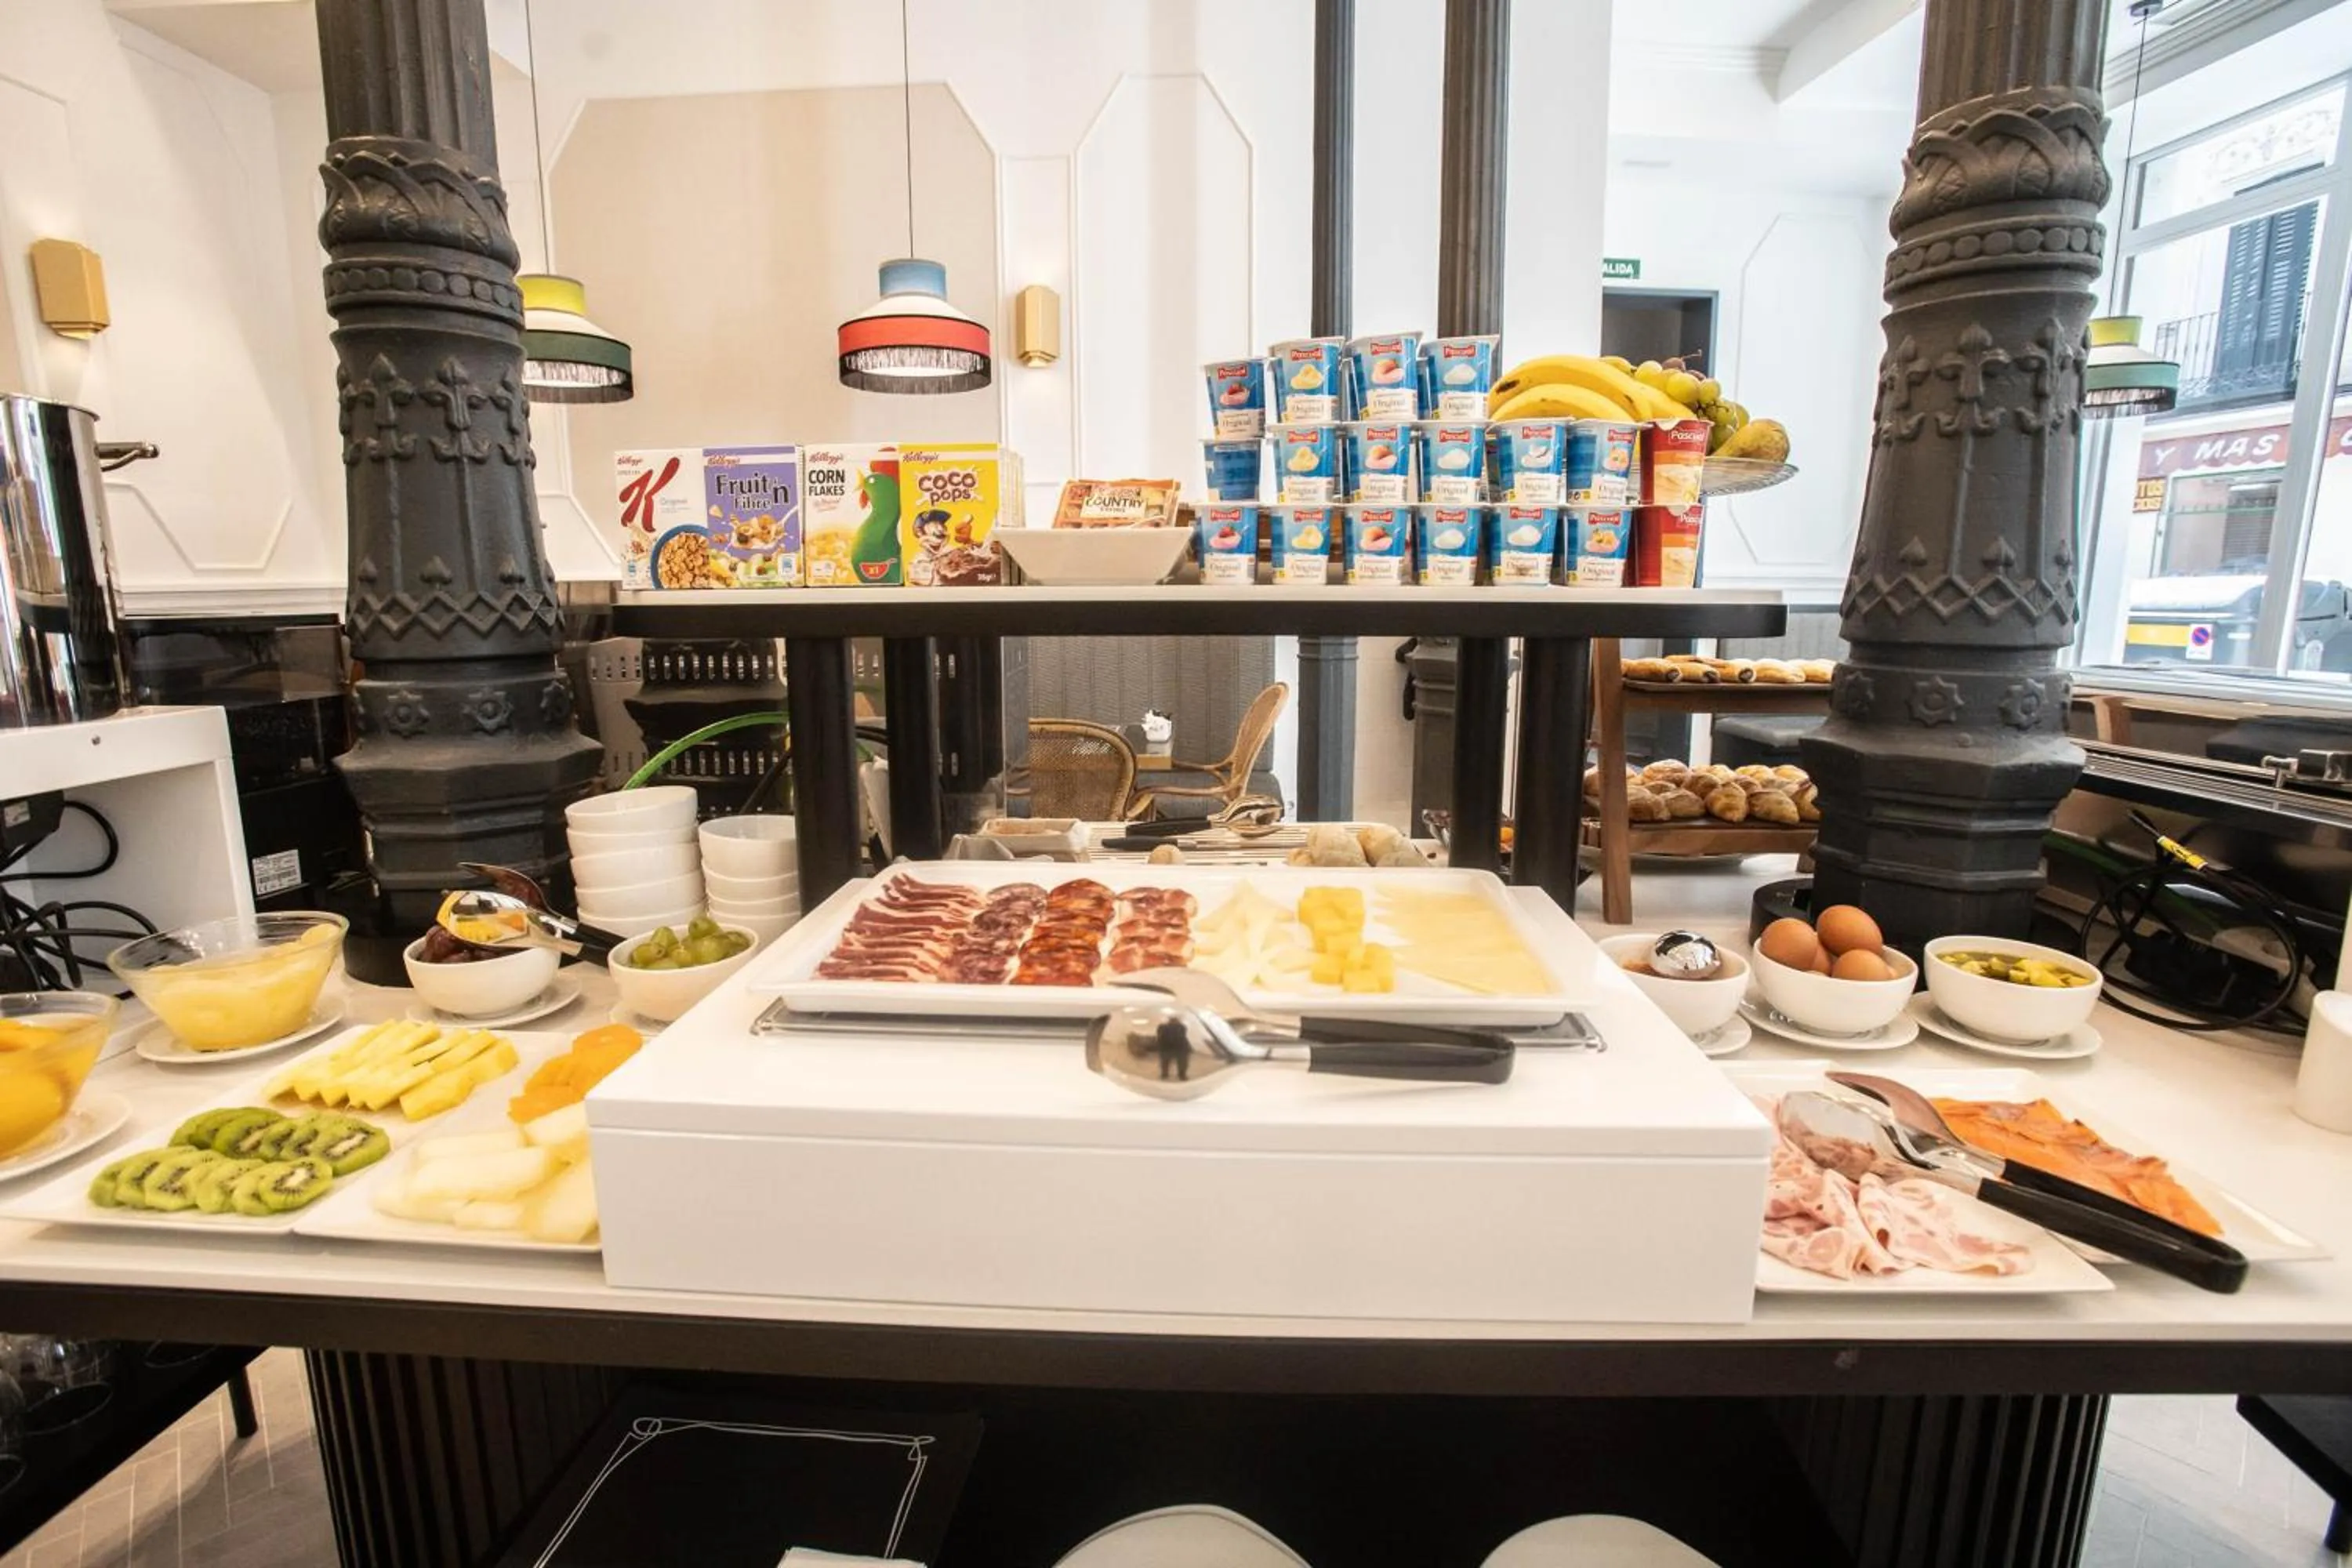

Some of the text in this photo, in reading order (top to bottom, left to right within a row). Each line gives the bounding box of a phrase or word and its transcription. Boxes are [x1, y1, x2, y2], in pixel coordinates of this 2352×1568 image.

[1602, 263, 1634, 274] ALIDA
[2155, 434, 2281, 466] Y MAS
[903, 452, 939, 464] Kellogg's
[715, 472, 768, 495] Fruit
[808, 470, 845, 484] CORN
[619, 456, 680, 533] K
[808, 485, 845, 495] FLAKES
